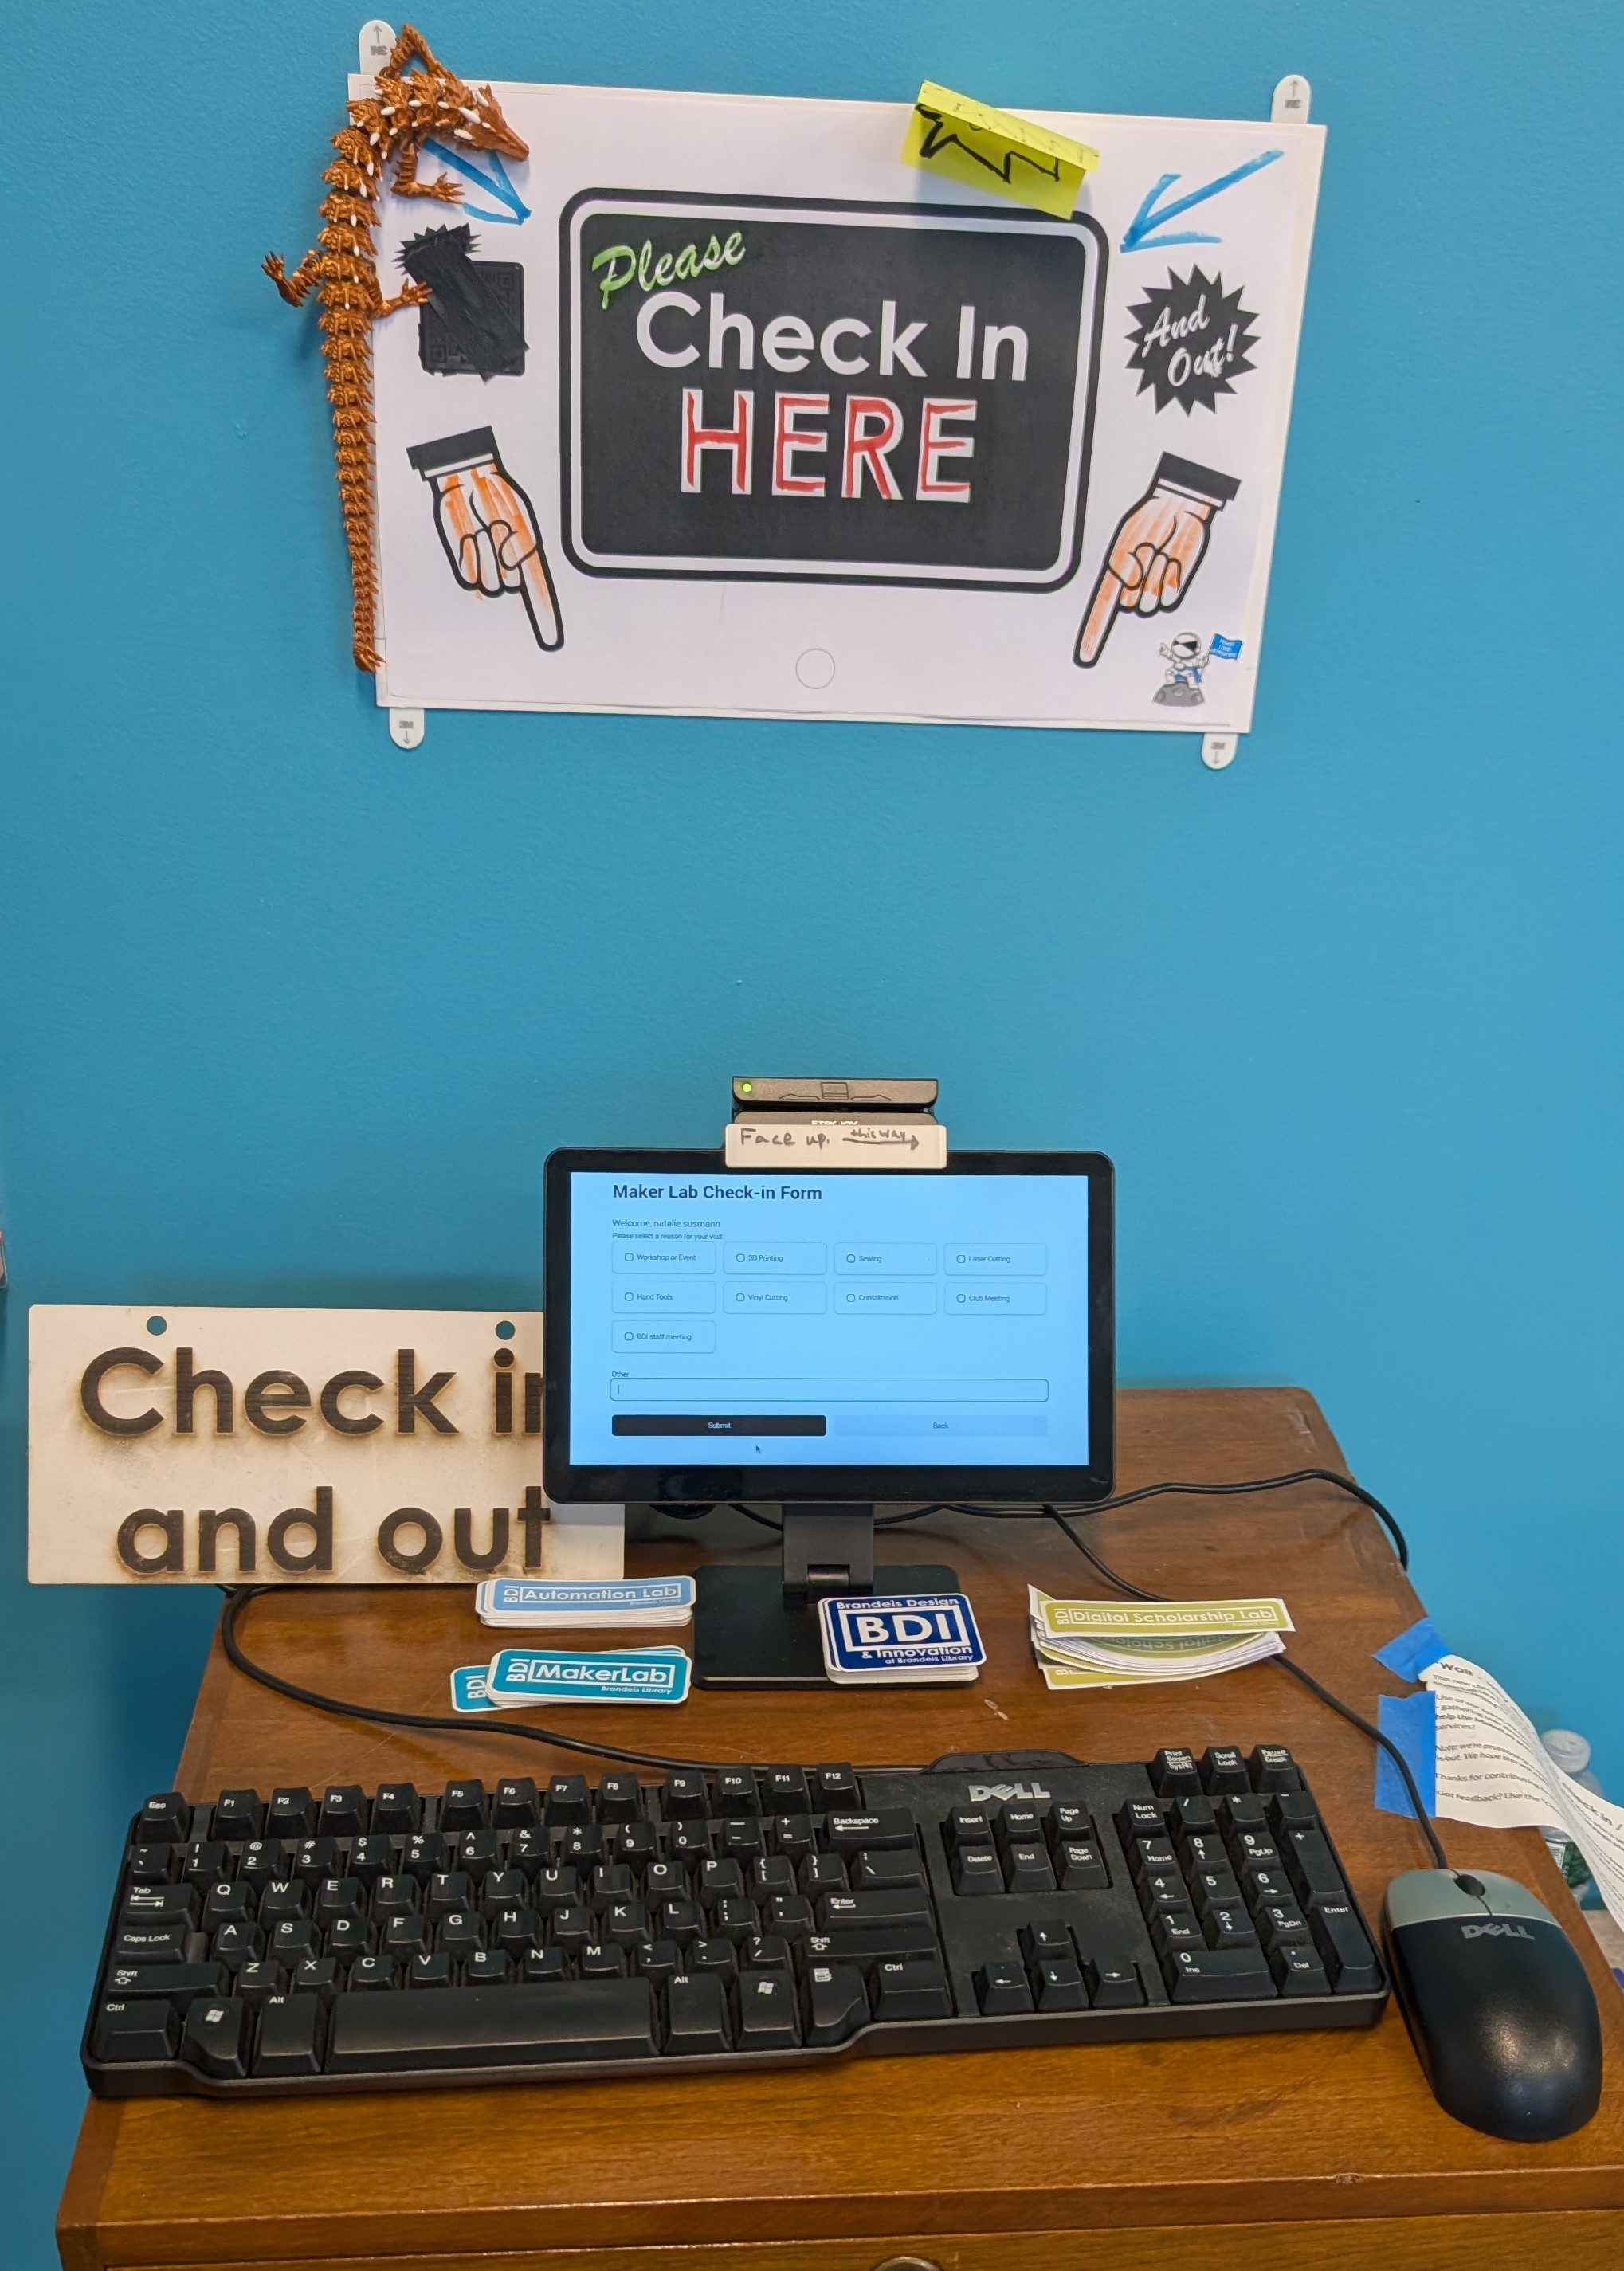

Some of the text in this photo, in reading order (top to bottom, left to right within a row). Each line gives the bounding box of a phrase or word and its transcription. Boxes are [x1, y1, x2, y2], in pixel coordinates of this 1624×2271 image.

[592, 231, 747, 309] Please
[1142, 293, 1210, 359] And
[635, 290, 1030, 381] Check In
[1167, 324, 1238, 387] Out!
[681, 387, 978, 503] HERE
[741, 1128, 795, 1146] Face
[850, 1128, 876, 1139] this
[614, 1184, 822, 1199] Maker Lab Check-in Form
[80, 1346, 460, 1434] Check
[116, 1485, 551, 1573] and out
[504, 1585, 519, 1603] BDI
[524, 1586, 677, 1602] Automation Lab
[837, 1598, 959, 1609] Brandeis Design
[1054, 1608, 1070, 1625] BDI
[1074, 1609, 1273, 1624] Digital Scholarship Lab
[856, 1613, 952, 1643] BDI
[877, 1646, 973, 1658] Innovation
[506, 1658, 531, 1682] BDI
[536, 1664, 667, 1684] MakerLab
[466, 1674, 485, 1699] BDI
[1435, 1772, 1467, 1782] Thanks
[968, 1783, 1050, 1802] DELL
[1456, 1793, 1502, 1802] feedback?
[1061, 1814, 1074, 1822] Up
[599, 1867, 604, 1877] I
[653, 1864, 668, 1875] O
[706, 1861, 718, 1872] P
[437, 1873, 449, 1885] T
[492, 1871, 505, 1883] Y
[546, 1869, 559, 1881] U
[216, 1884, 231, 1896] Q
[271, 1881, 289, 1893] W
[327, 1880, 339, 1891] E
[381, 1877, 394, 1889] R
[1460, 1922, 1536, 1941] DELL
[116, 1970, 138, 1979] Shift
